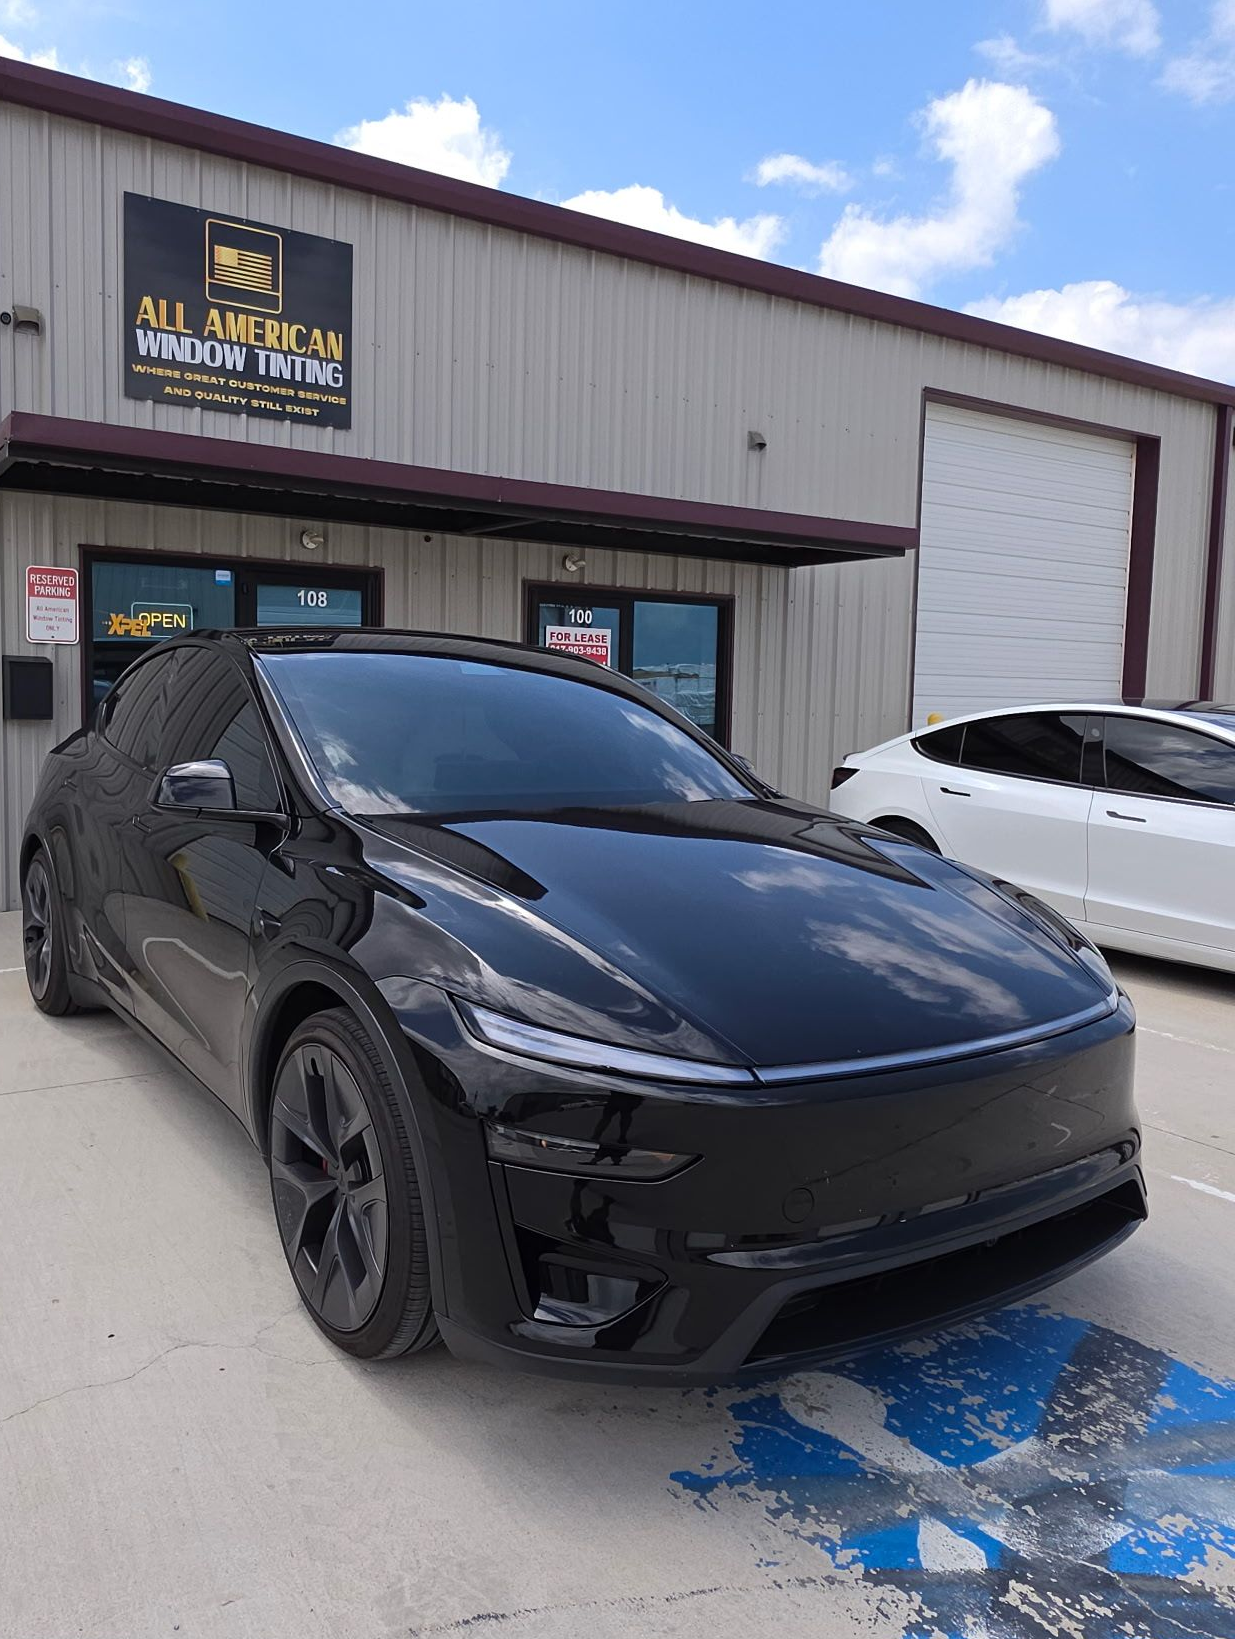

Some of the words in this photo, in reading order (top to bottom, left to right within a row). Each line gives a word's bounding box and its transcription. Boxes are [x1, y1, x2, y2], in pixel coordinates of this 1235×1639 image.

[136, 295, 193, 334] ALL
[203, 308, 343, 361] AMERICAN
[135, 328, 247, 372] WINDOW
[254, 349, 343, 388] TINTING
[131, 363, 181, 379] WHERE
[183, 372, 226, 386] GREAT
[228, 379, 295, 397] CUSTOMER
[297, 390, 347, 405] SERVICE
[163, 386, 192, 397] AND
[194, 391, 248, 406] QUALITY
[250, 399, 283, 411] STILL
[285, 404, 320, 416] EXIST
[29, 573, 75, 587] RESERVED
[34, 585, 71, 598] PARKING
[297, 590, 328, 607] 108
[107, 612, 152, 637] XPEL
[138, 612, 186, 629] OPEN
[568, 608, 593, 624] 100
[549, 632, 571, 642] FOR
[574, 633, 608, 644] LEASE
